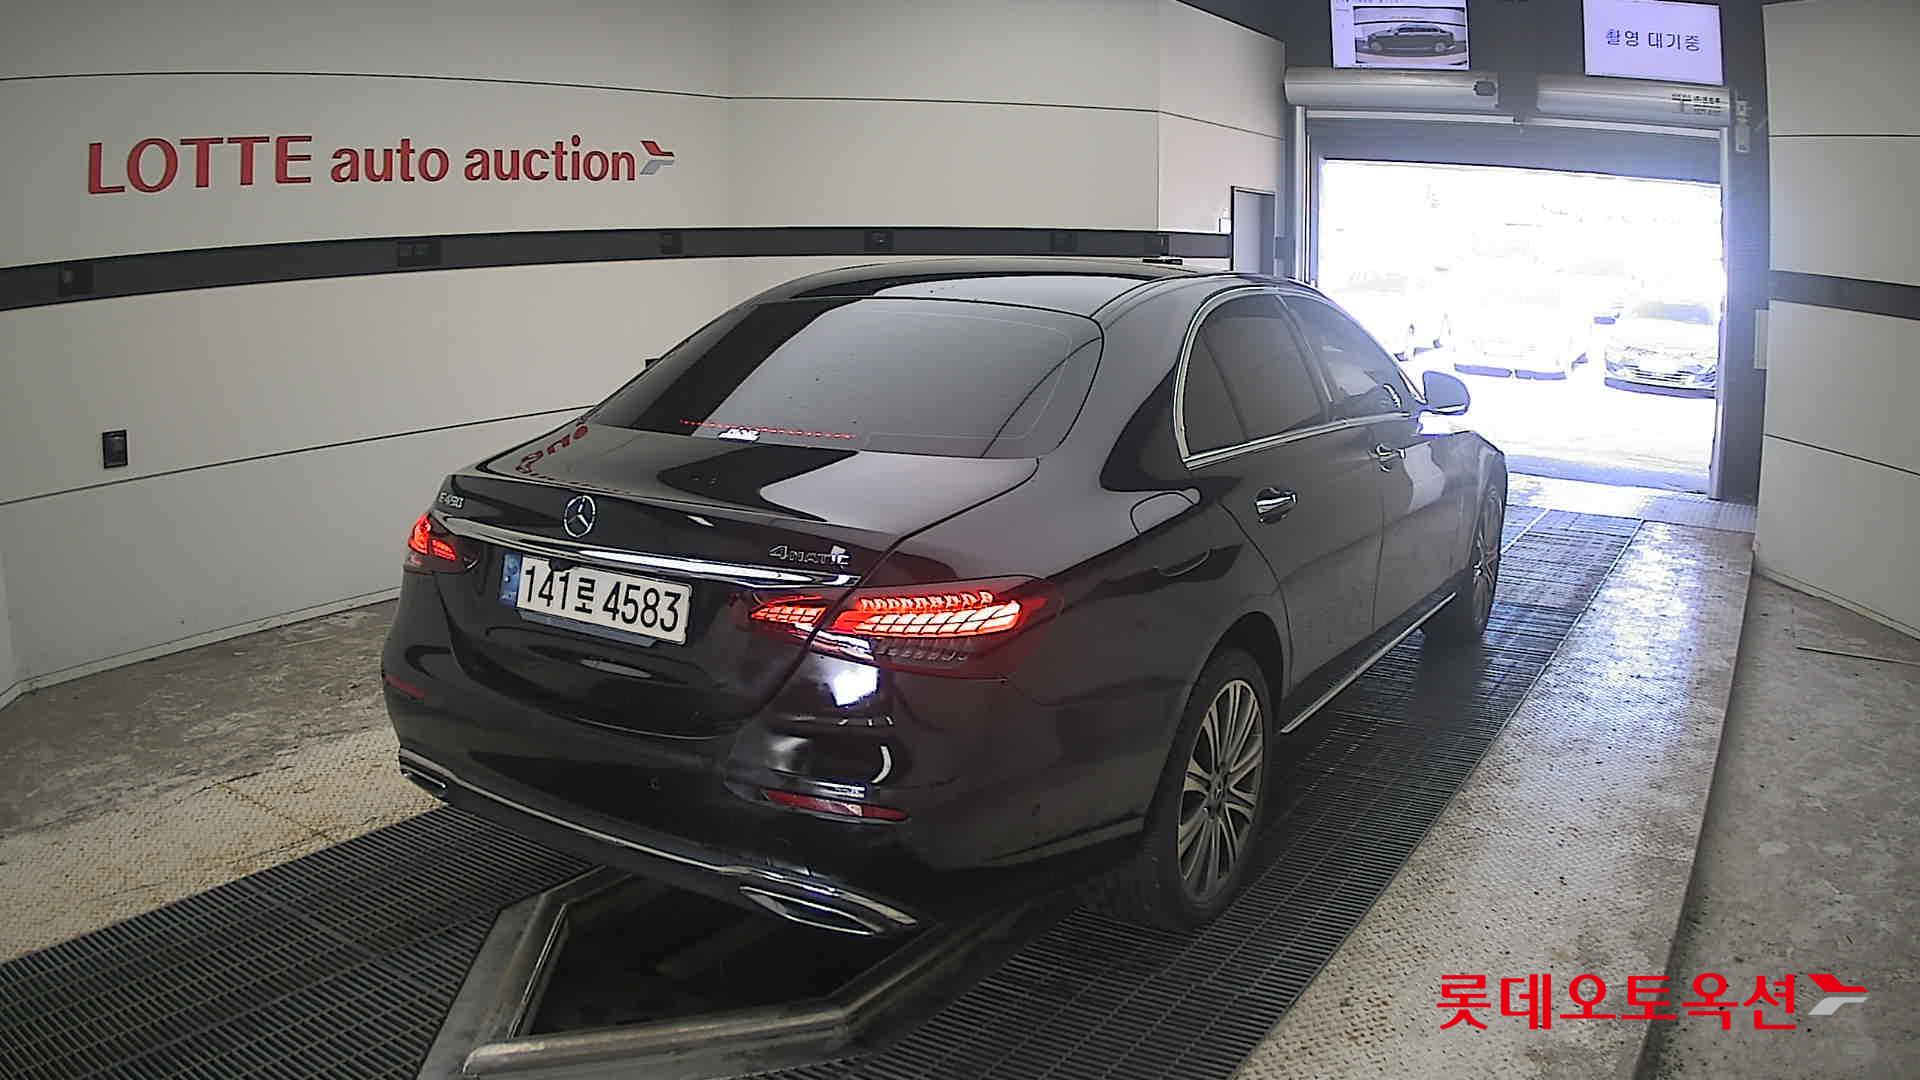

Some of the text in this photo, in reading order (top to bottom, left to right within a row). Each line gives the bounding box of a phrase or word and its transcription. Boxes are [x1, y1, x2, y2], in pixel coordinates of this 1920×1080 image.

[1647, 32, 1700, 52] 대기중
[88, 135, 637, 194] LOTTE auto auction
[602, 581, 682, 632] 4583
